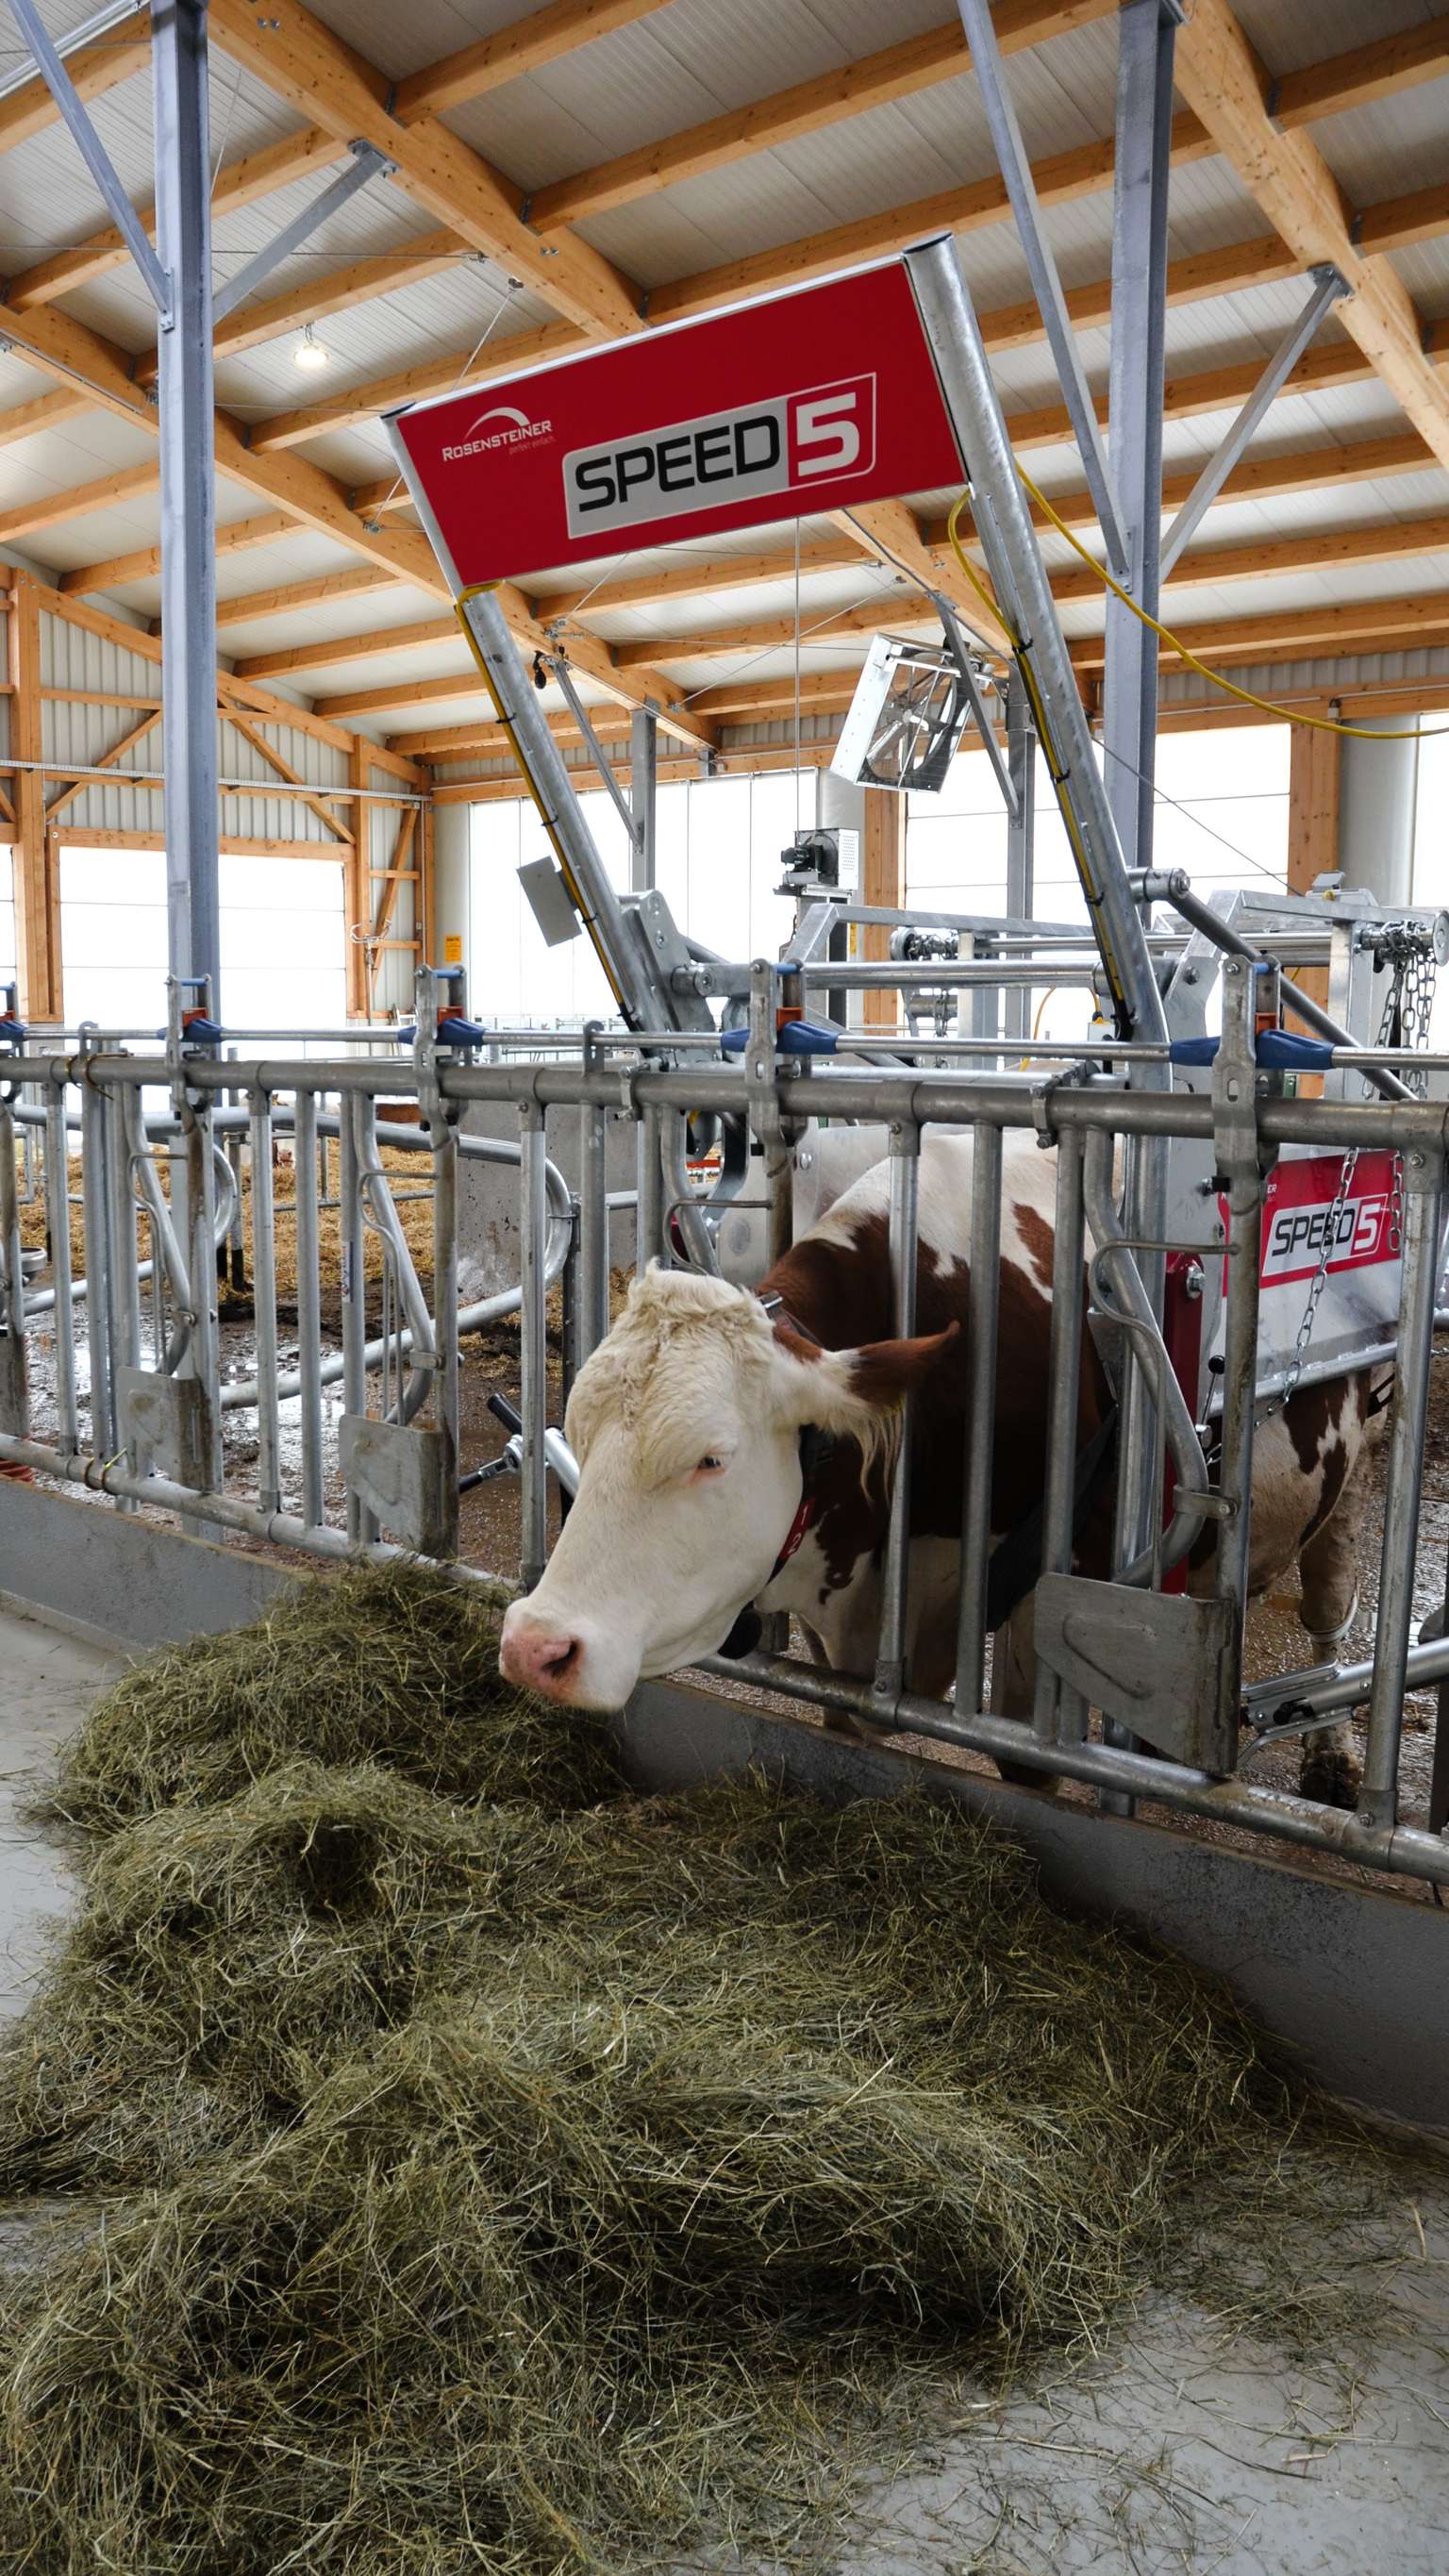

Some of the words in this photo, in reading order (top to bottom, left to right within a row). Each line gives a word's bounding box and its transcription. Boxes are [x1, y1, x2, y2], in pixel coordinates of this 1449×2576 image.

[441, 420, 552, 461] ROSENSTEINER
[575, 415, 780, 512] SPEED
[796, 391, 859, 476] 5
[1354, 1203, 1381, 1250] 5
